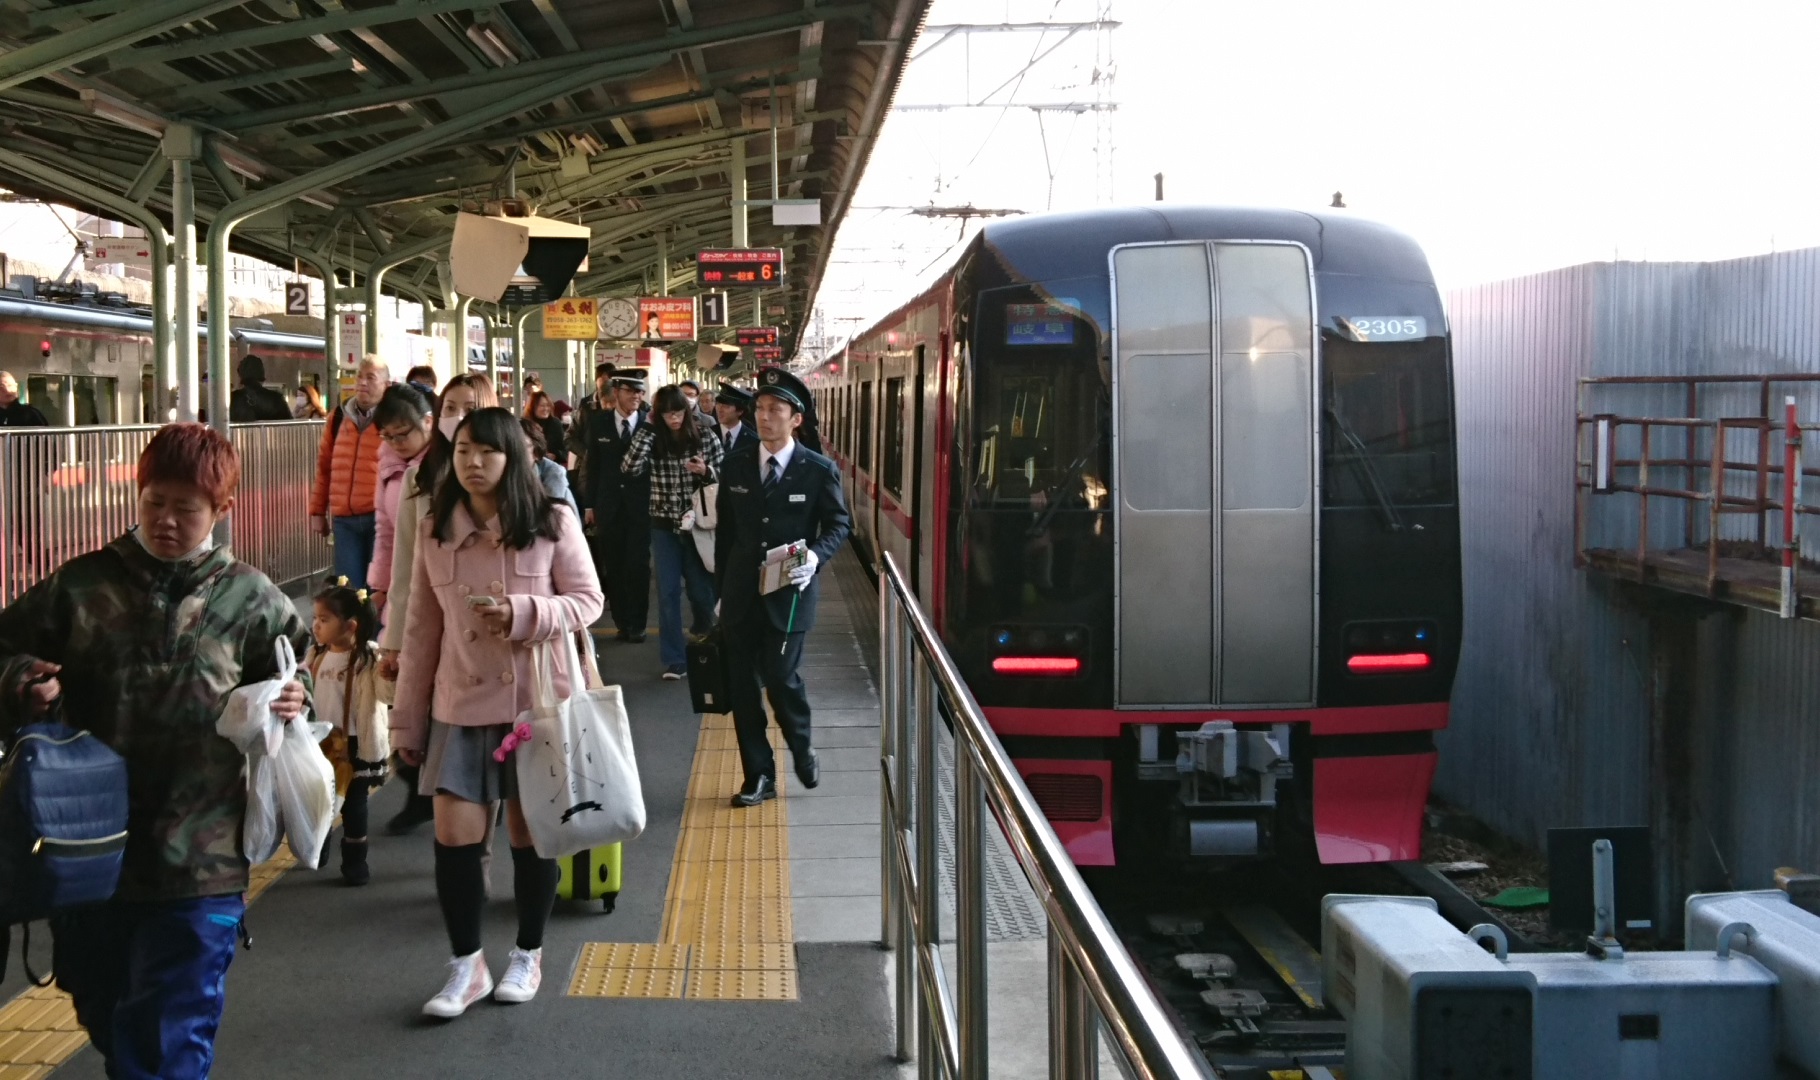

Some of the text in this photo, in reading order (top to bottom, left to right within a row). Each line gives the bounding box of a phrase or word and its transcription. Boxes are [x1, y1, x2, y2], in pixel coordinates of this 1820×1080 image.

[761, 264, 772, 280] 6
[289, 287, 306, 311] 2
[640, 302, 692, 312] なおみ皮フ科
[705, 297, 717, 321] 1
[1012, 323, 1066, 337] 岐阜
[1355, 319, 1417, 335] 2305
[767, 334, 773, 343] 5
[596, 353, 633, 363] コーナー
